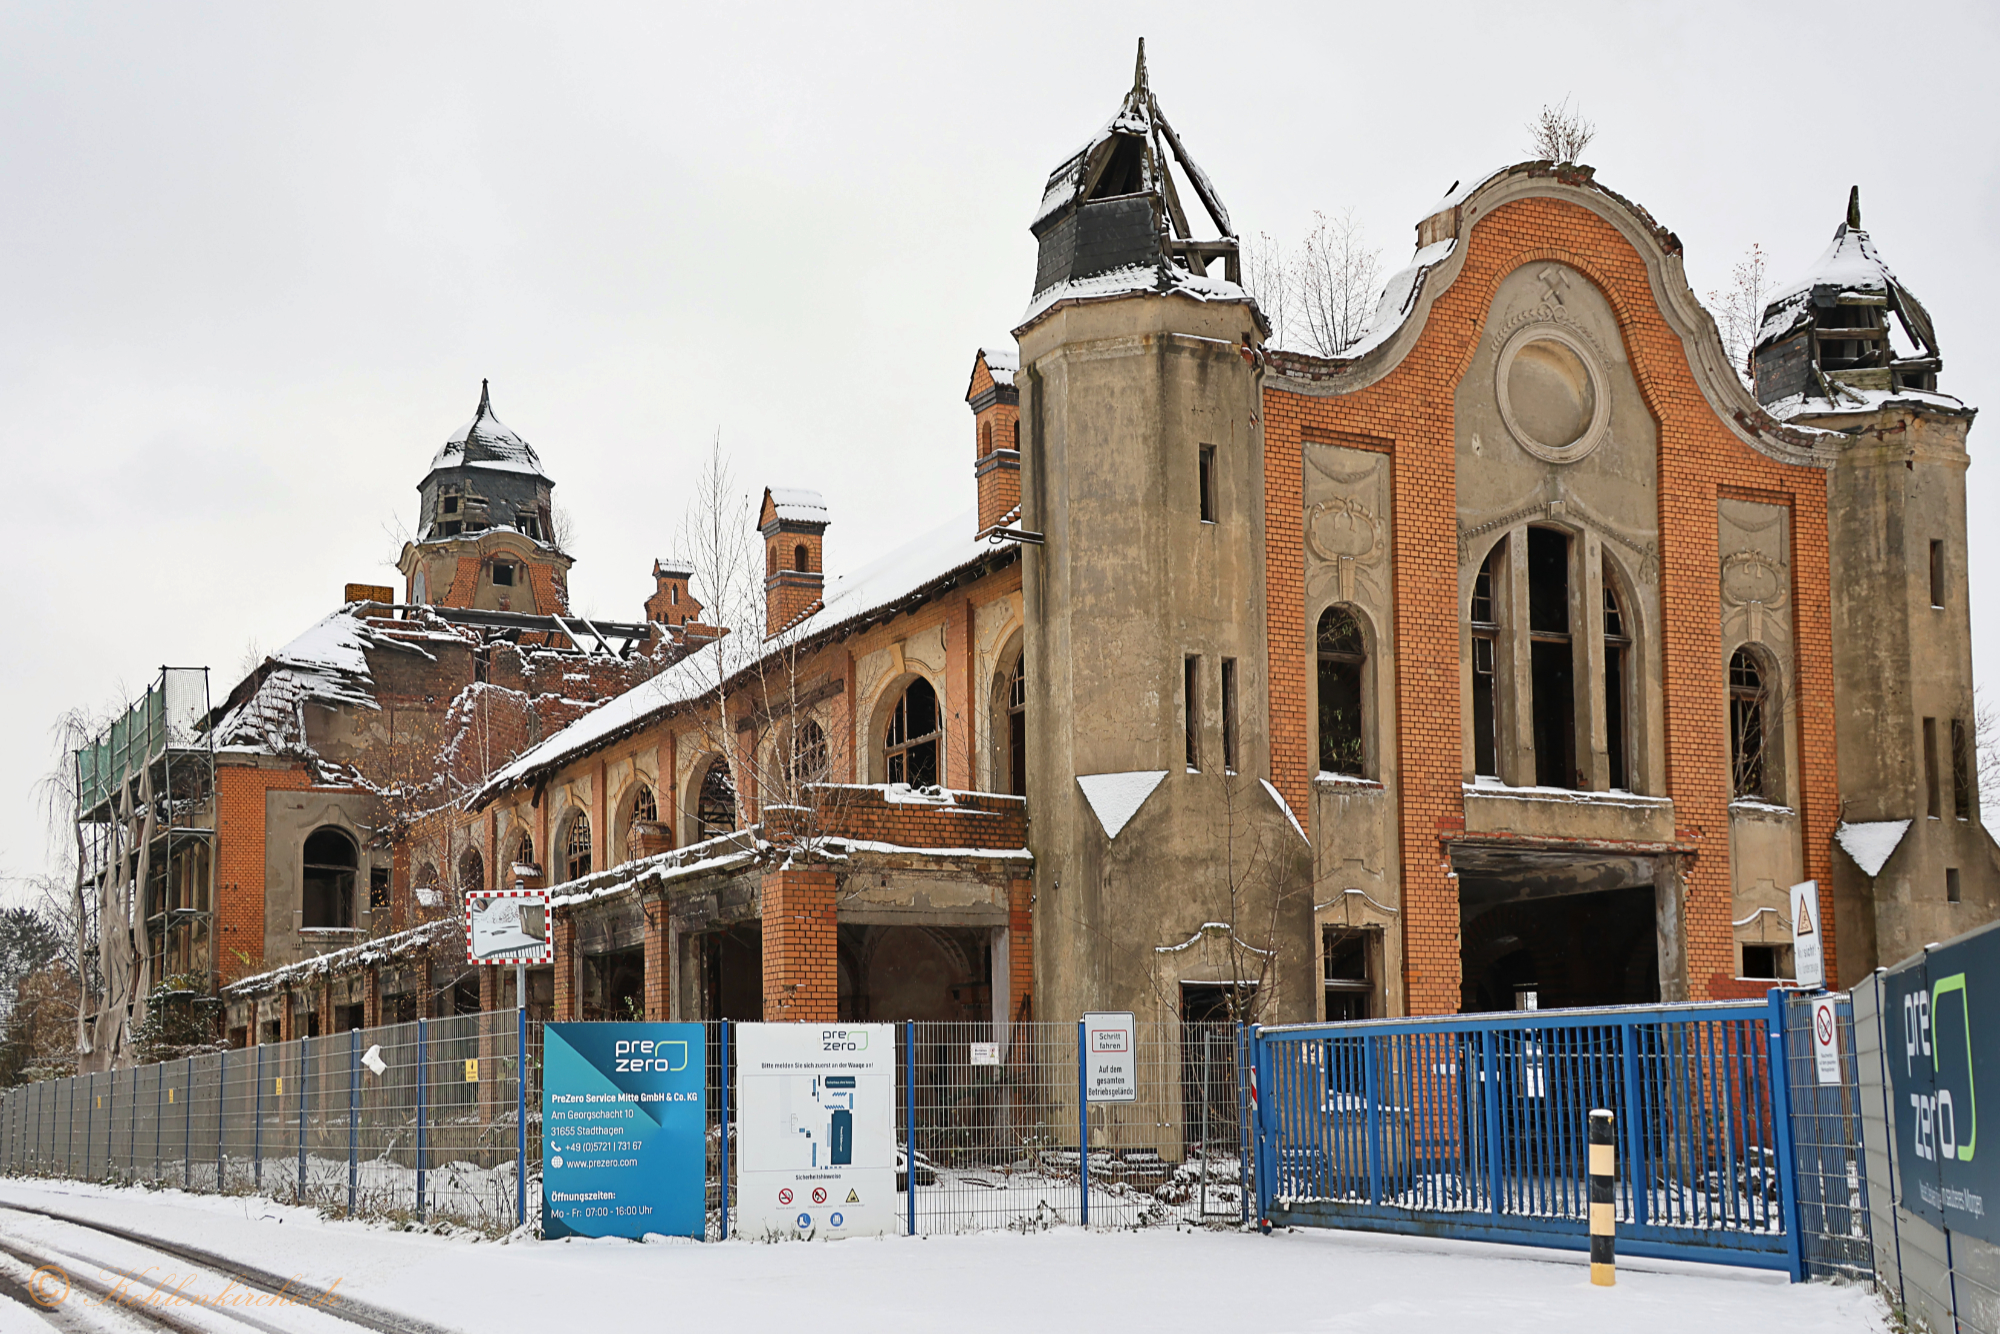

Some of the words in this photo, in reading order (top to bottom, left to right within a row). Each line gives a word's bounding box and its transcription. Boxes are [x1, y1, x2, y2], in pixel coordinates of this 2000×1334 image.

[822, 1030, 847, 1041] pre
[1099, 1032, 1121, 1040] Schritt
[1904, 990, 1931, 1078] pre
[615, 1040, 654, 1057] pre
[823, 1042, 856, 1051] zero
[615, 1059, 669, 1072] zero
[1098, 1065, 1109, 1073] Auf
[1110, 1065, 1122, 1073] dem
[1096, 1076, 1125, 1087] gesamten
[551, 1093, 583, 1103] PreZero
[586, 1093, 616, 1103] Service
[618, 1092, 639, 1102] Mitte
[640, 1092, 664, 1102] GmbH
[666, 1092, 673, 1102] &
[673, 1092, 686, 1102] Co.
[687, 1092, 698, 1101] KG
[1088, 1087, 1134, 1098] Betriebsgelände
[551, 1110, 566, 1120] Am
[567, 1109, 623, 1121] Georgschacht
[624, 1109, 634, 1119] 10
[1910, 1089, 1956, 1162] zero
[550, 1126, 576, 1136] 31655
[576, 1126, 624, 1137] Stadthagen
[565, 1142, 581, 1152] +49
[582, 1141, 611, 1153] (0)5721
[617, 1141, 631, 1151] 731
[632, 1141, 643, 1151] 67
[566, 1158, 638, 1169] www.prezero.com
[795, 1173, 841, 1181] Sicherheitshinweise
[551, 1190, 616, 1203] Öffnungszeiten:
[551, 1209, 565, 1219] Mo
[571, 1208, 582, 1218] Fr:
[585, 1207, 608, 1218] 07:00
[615, 1206, 637, 1216] 16:00
[638, 1205, 653, 1215] Uhr
